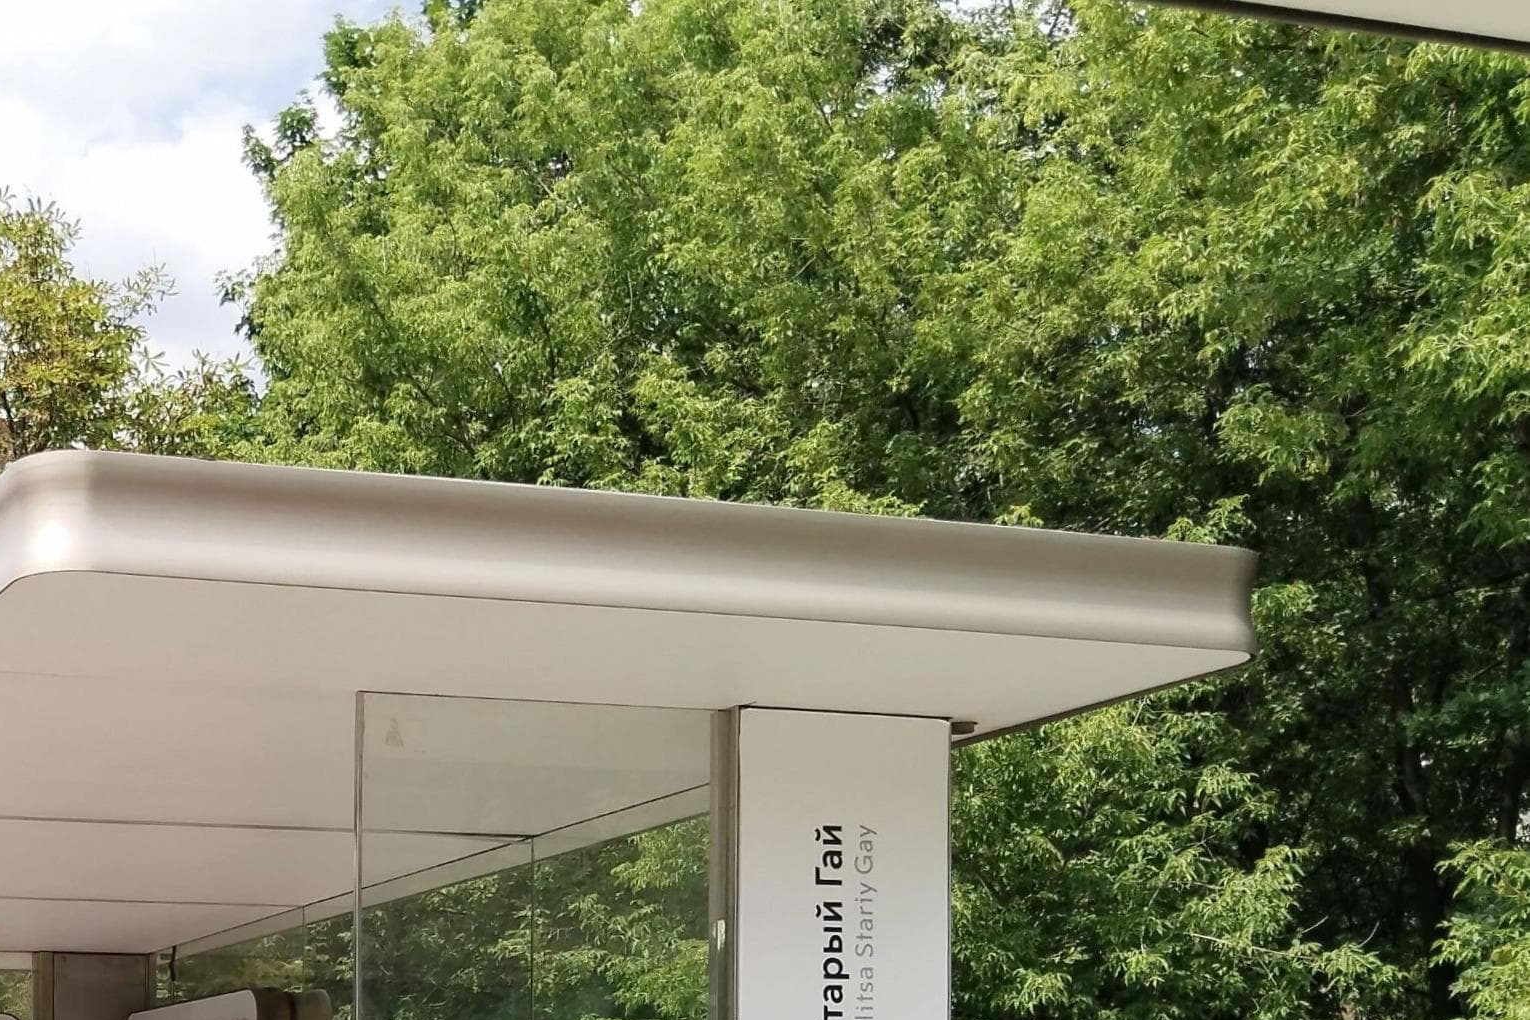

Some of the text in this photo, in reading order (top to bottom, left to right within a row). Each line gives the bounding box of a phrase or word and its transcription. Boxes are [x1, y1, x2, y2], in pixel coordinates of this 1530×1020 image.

[814, 824, 843, 887] Гай
[854, 823, 878, 874] Gay
[854, 881, 878, 957] Stariy
